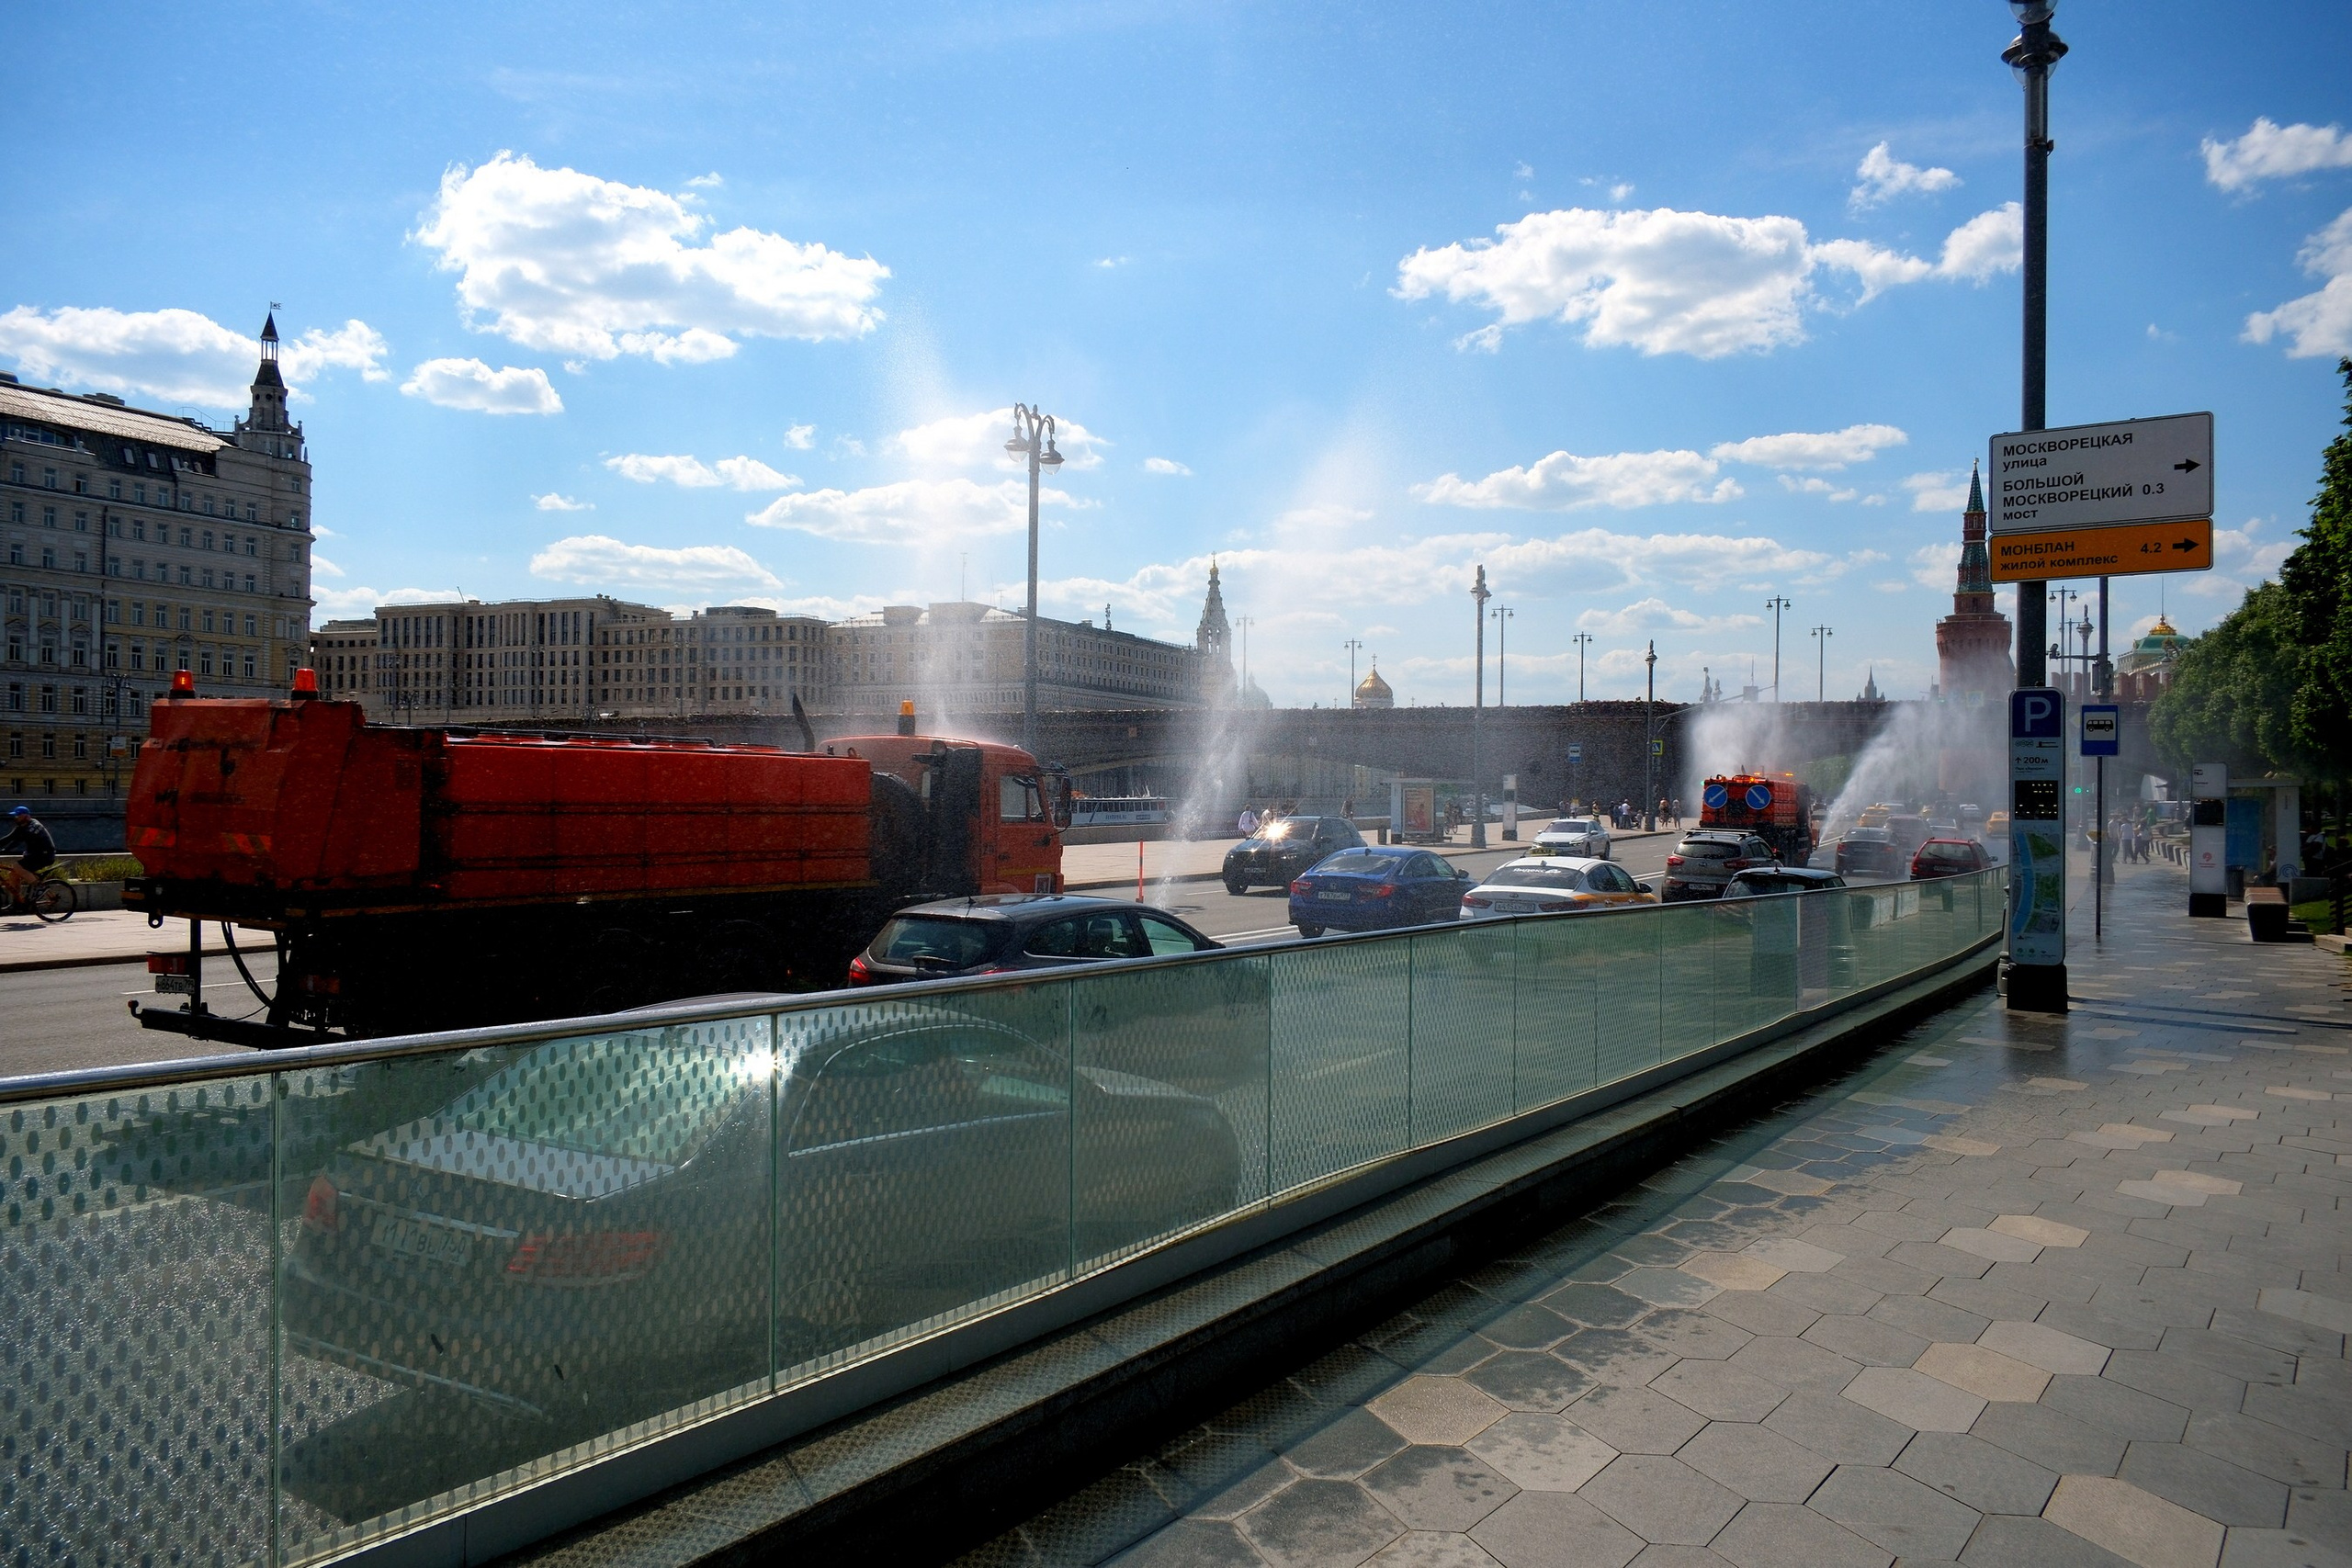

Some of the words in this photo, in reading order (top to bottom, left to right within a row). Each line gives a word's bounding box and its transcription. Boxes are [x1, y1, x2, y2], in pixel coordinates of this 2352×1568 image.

[2003, 433, 2133, 457] МОСКВОРЕЦКАЯ
[2002, 457, 2047, 472] улица
[2003, 472, 2084, 491] БОЛЬШОЙ
[2003, 484, 2133, 507] МОСКВОРЕЦКИЙ
[2142, 482, 2165, 495] 0.3
[2003, 509, 2038, 521] мост
[2000, 541, 2075, 557] МОНБЛАН
[2140, 542, 2162, 554] 4.2
[2000, 558, 2046, 571] жилой
[2050, 554, 2119, 570] комплекс
[2024, 696, 2052, 732] P
